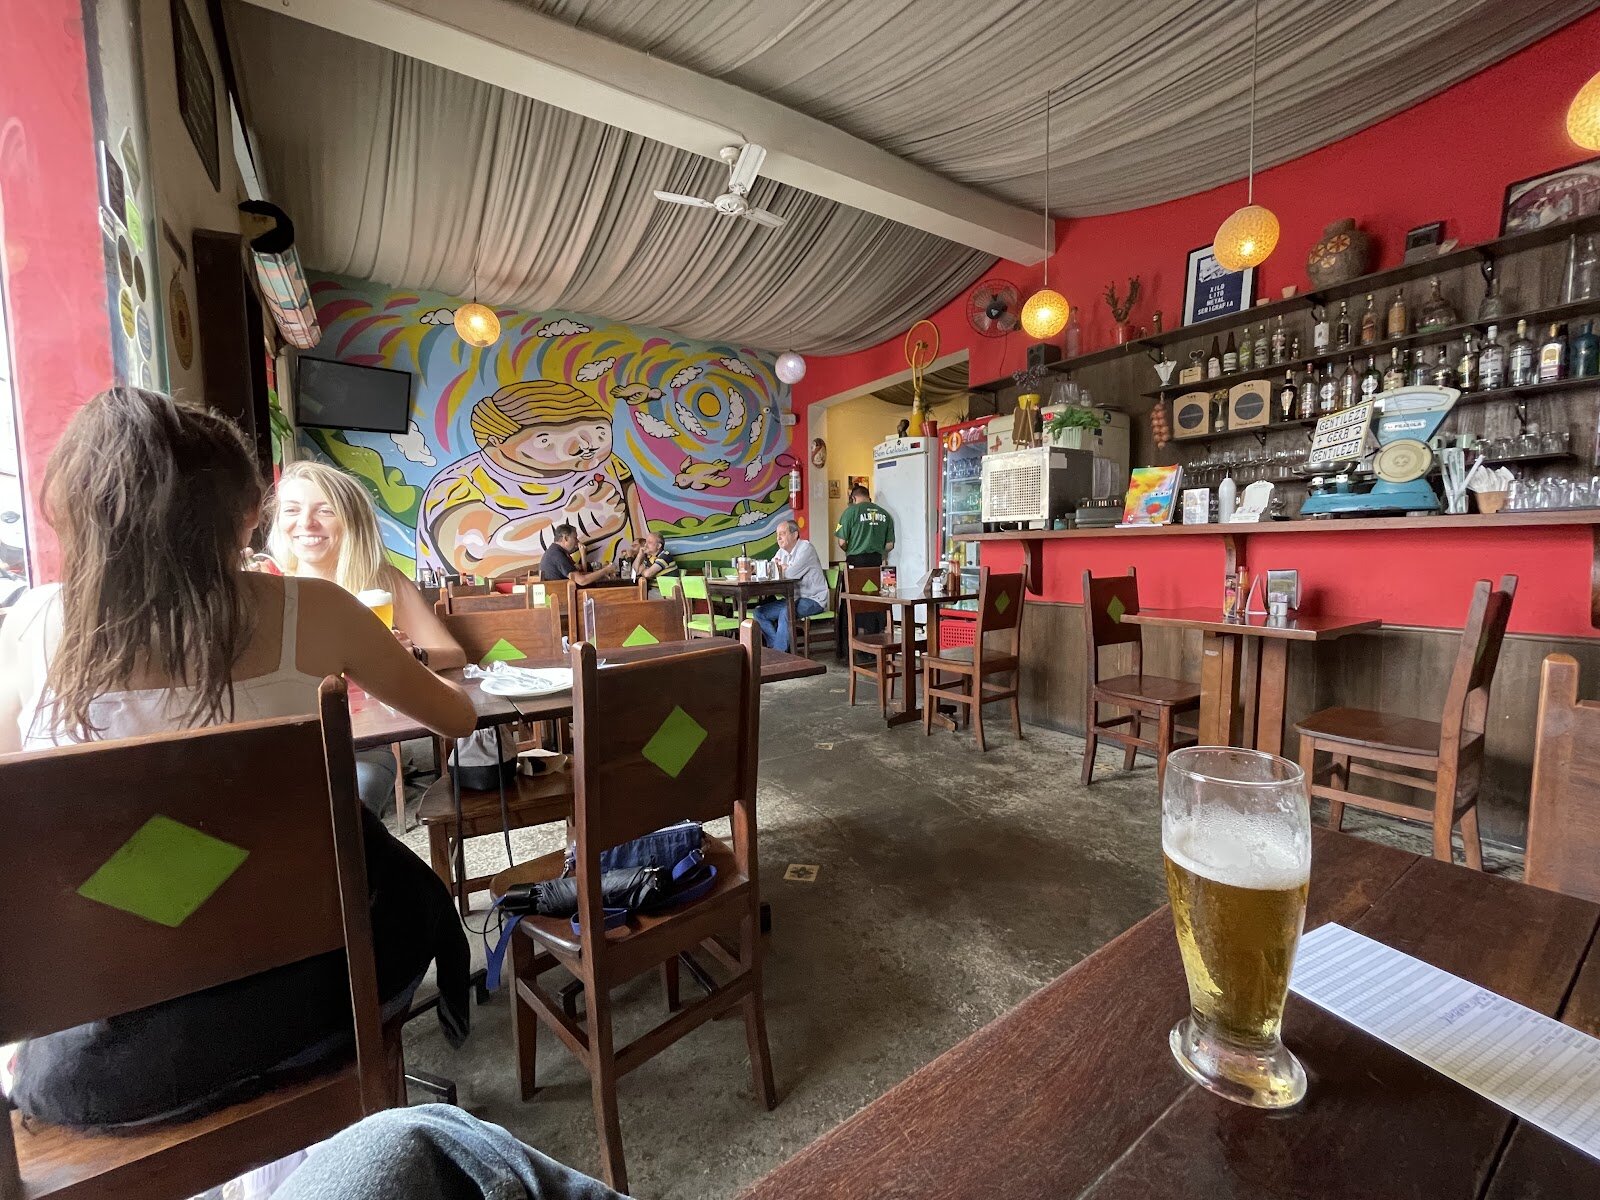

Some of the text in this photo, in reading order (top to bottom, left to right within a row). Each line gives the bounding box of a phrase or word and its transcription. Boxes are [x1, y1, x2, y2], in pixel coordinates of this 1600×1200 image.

[1208, 290, 1225, 300] LITO
[1319, 407, 1367, 431] GENTILEZA
[1326, 427, 1350, 443] GERA
[1312, 441, 1360, 463] GENTILEZA
